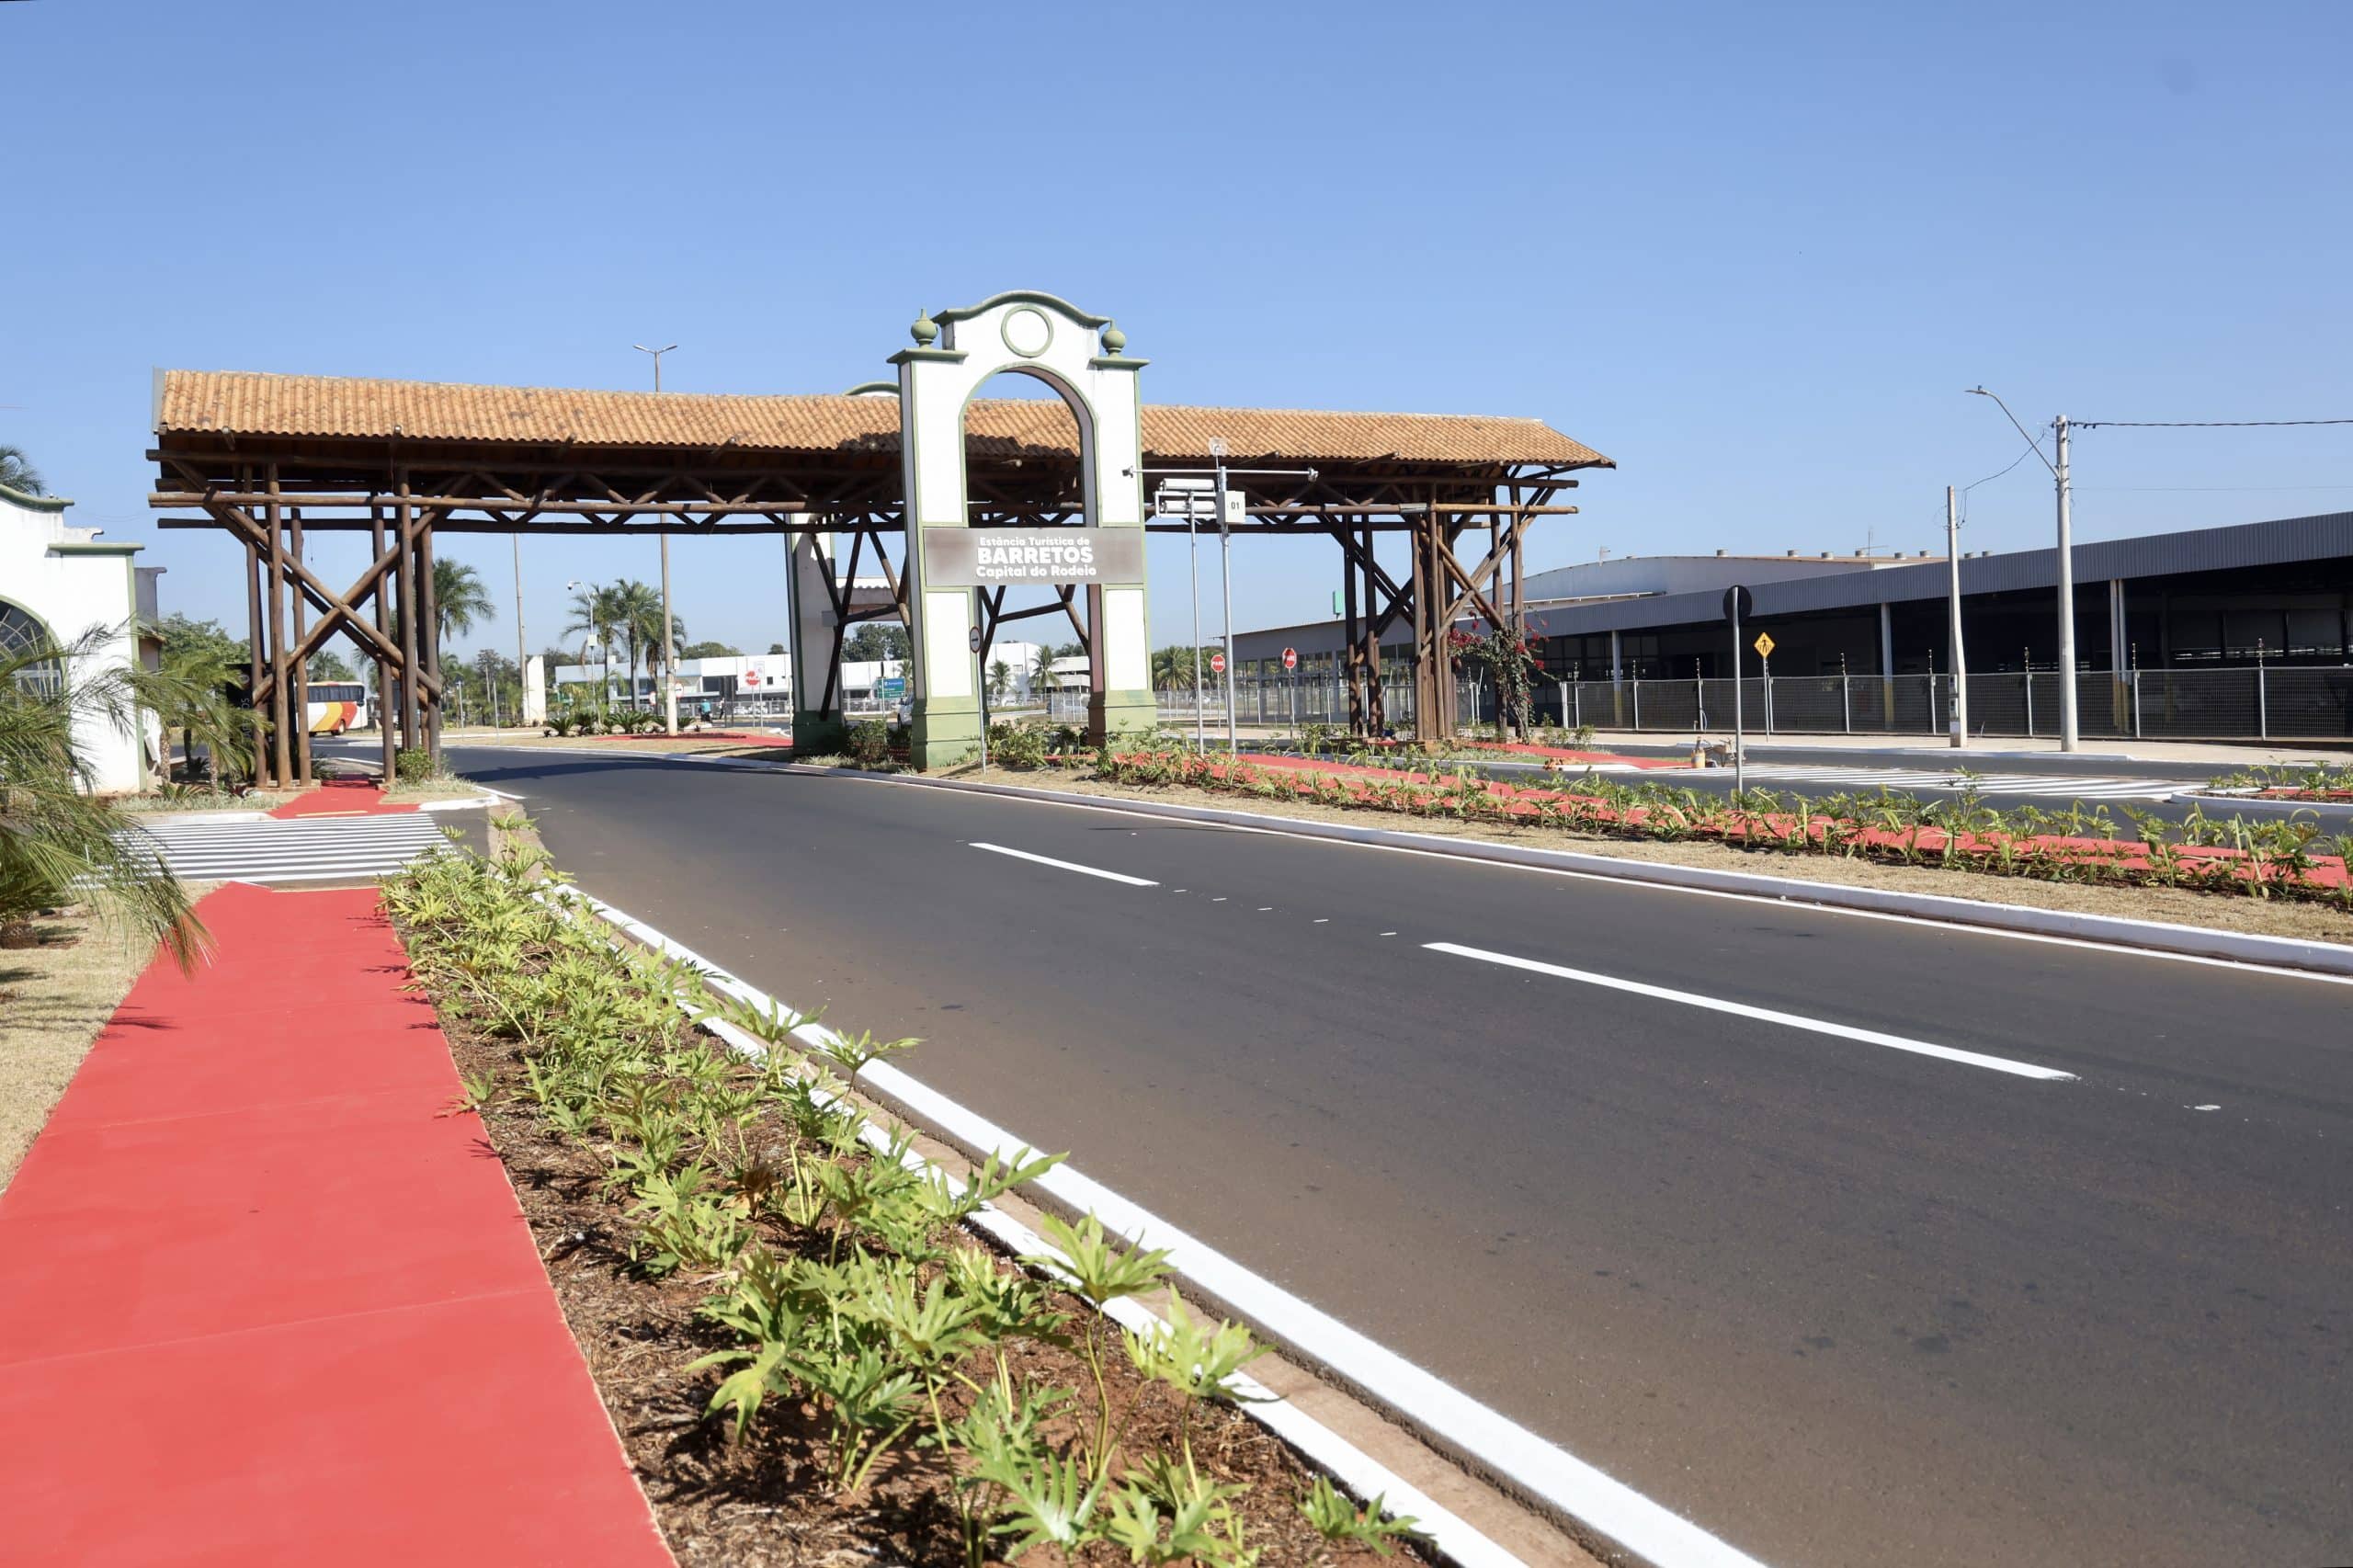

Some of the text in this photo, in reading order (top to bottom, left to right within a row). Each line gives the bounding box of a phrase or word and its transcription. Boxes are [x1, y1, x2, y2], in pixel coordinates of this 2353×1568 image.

[980, 537, 1026, 546] Estância
[1076, 537, 1090, 546] de
[977, 546, 1094, 563] BARRETOS
[976, 565, 1097, 579] Capital do Rodeio
